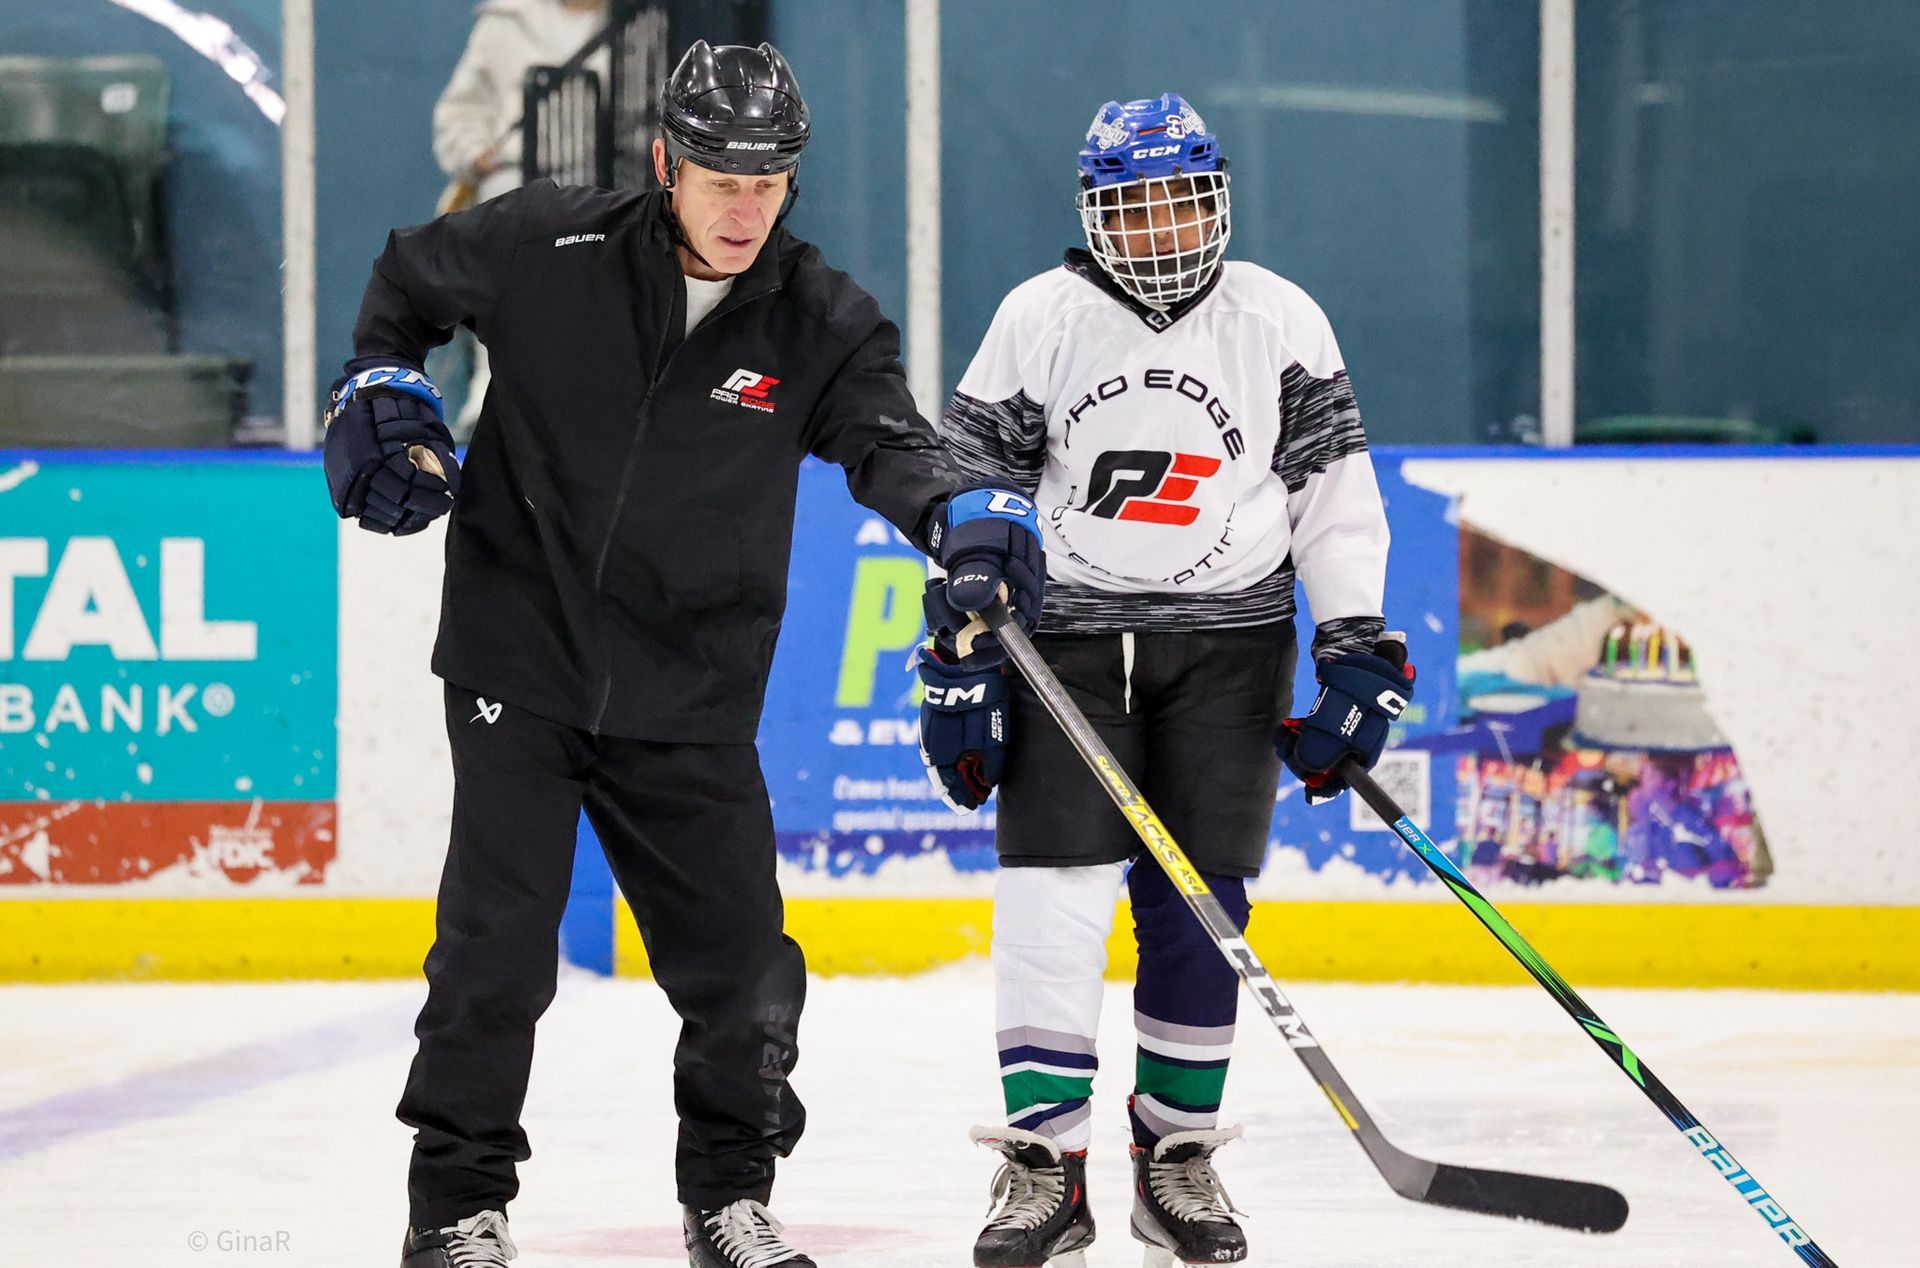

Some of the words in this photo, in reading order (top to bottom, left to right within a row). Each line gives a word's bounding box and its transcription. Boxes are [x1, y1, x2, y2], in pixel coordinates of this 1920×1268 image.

[726, 141, 777, 151] BAUER
[1132, 145, 1181, 159] CCM
[554, 233, 606, 247] BAUER
[711, 388, 739, 401] PRO
[1144, 369, 1245, 461] EDGE
[953, 574, 989, 587] CCM
[924, 684, 986, 706] CM
[1220, 934, 1320, 1050] CCM
[1682, 1124, 1812, 1250] BAUER
